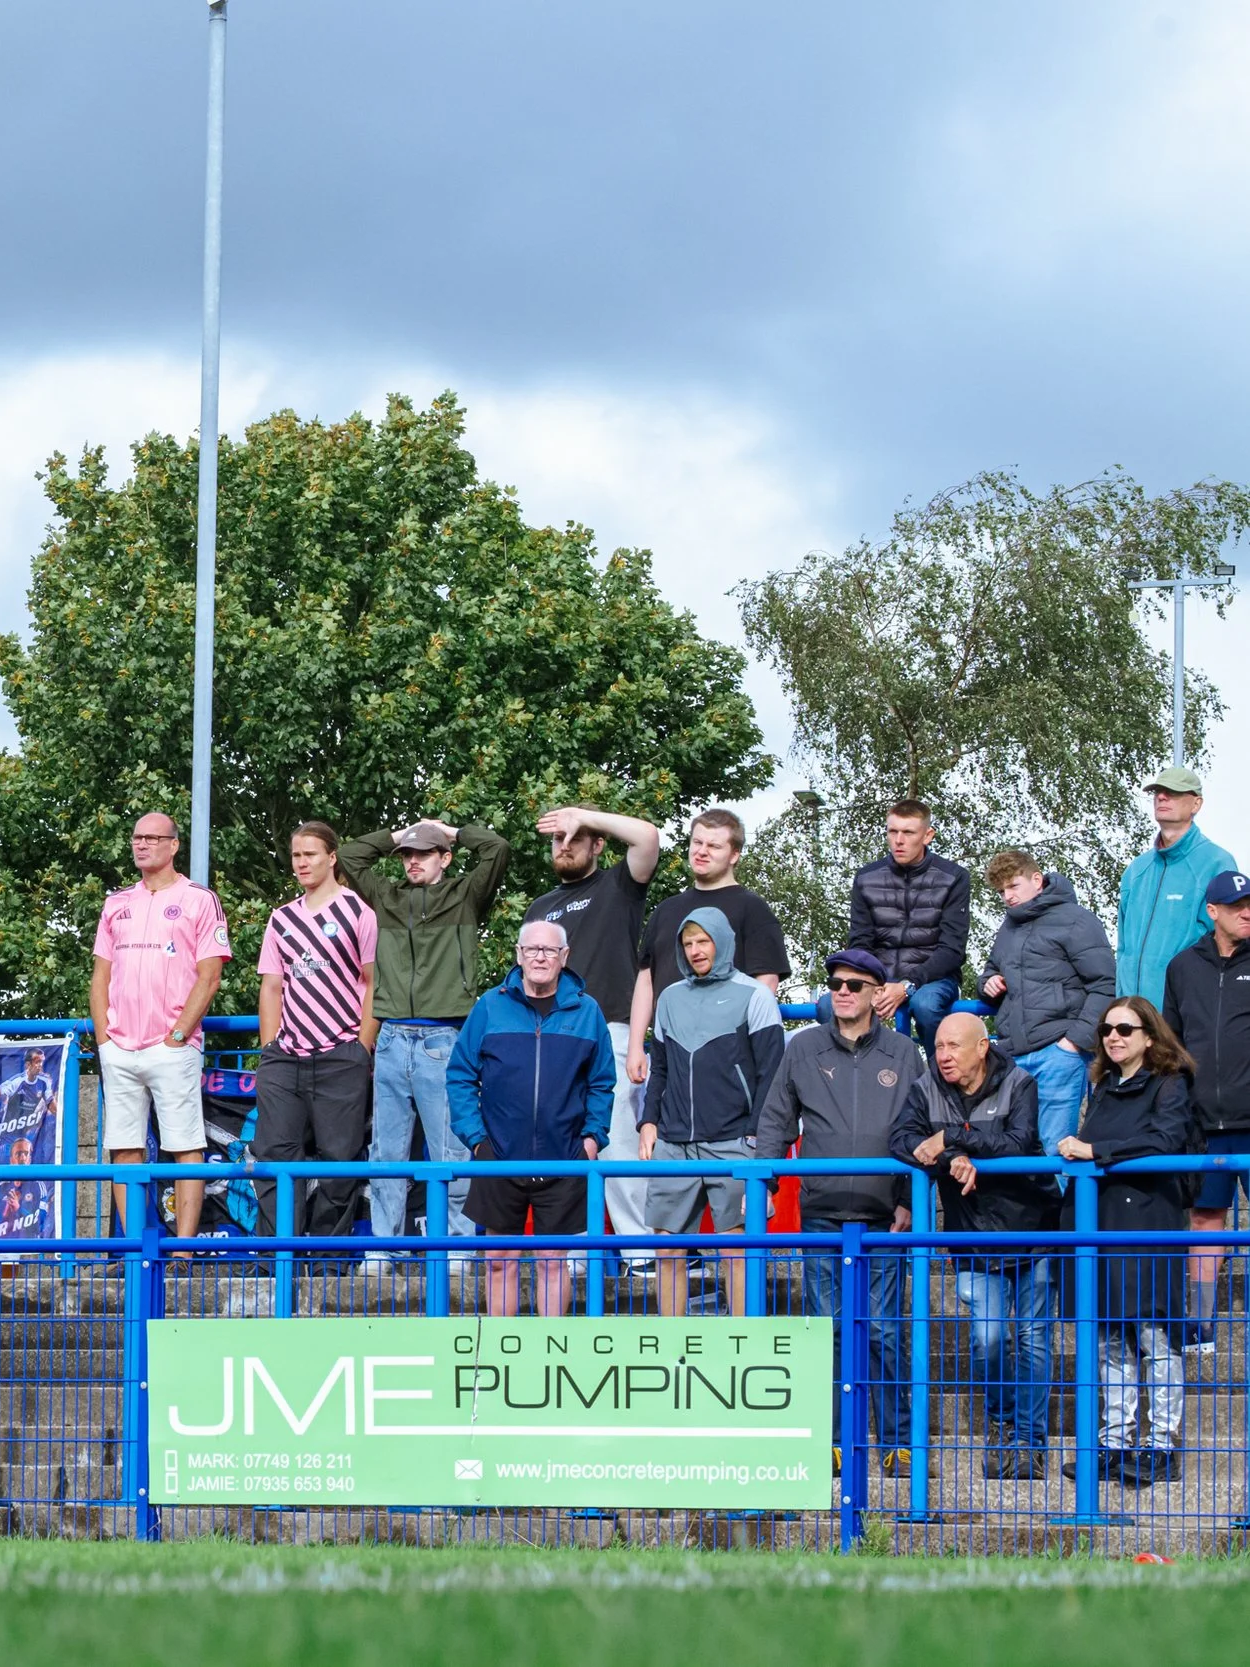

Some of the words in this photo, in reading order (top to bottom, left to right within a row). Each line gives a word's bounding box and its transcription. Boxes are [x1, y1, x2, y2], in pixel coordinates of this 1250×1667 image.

[1232, 876, 1246, 891] P
[454, 1334, 791, 1355] CONCRETE
[169, 1355, 435, 1436] JME
[454, 1364, 792, 1410] PUMPING
[188, 1453, 239, 1469] MARK:
[244, 1453, 290, 1469] 07749
[296, 1453, 322, 1469] 126
[326, 1453, 352, 1469] 211
[496, 1459, 809, 1485] www.jmeconcretepumping.co.uk
[187, 1475, 239, 1492] JAMIE:
[244, 1476, 290, 1492] 07935
[294, 1476, 322, 1492] 653
[326, 1476, 354, 1492] 940
